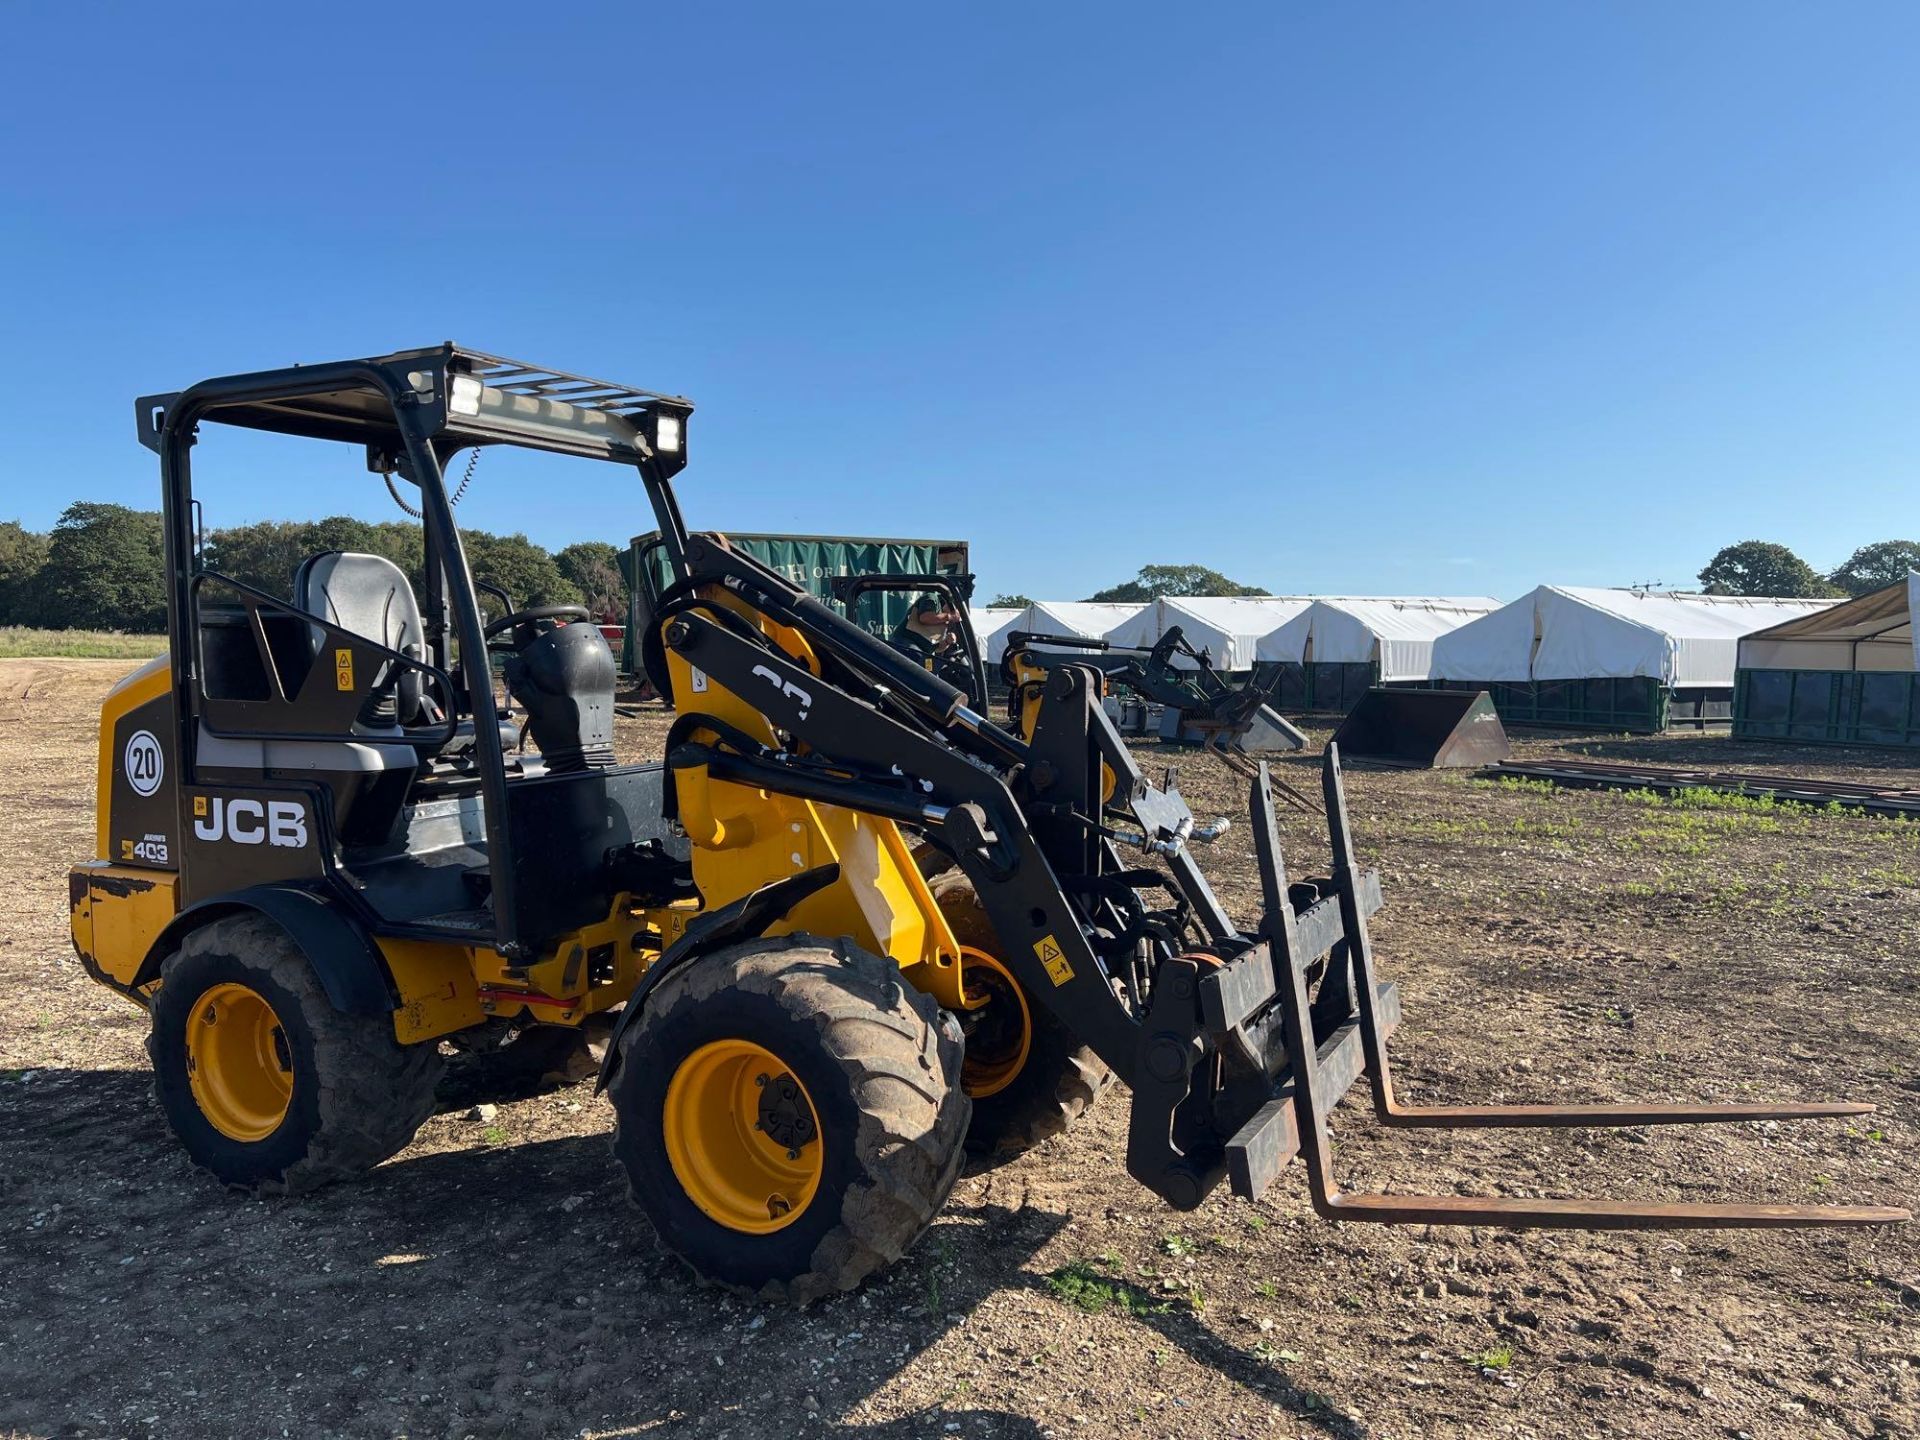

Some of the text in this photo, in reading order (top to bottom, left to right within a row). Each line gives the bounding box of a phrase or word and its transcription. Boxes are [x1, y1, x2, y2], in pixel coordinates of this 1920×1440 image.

[812, 566, 833, 579] OF
[133, 747, 156, 779] 20
[194, 797, 307, 849] JCB
[134, 842, 168, 861] 403
